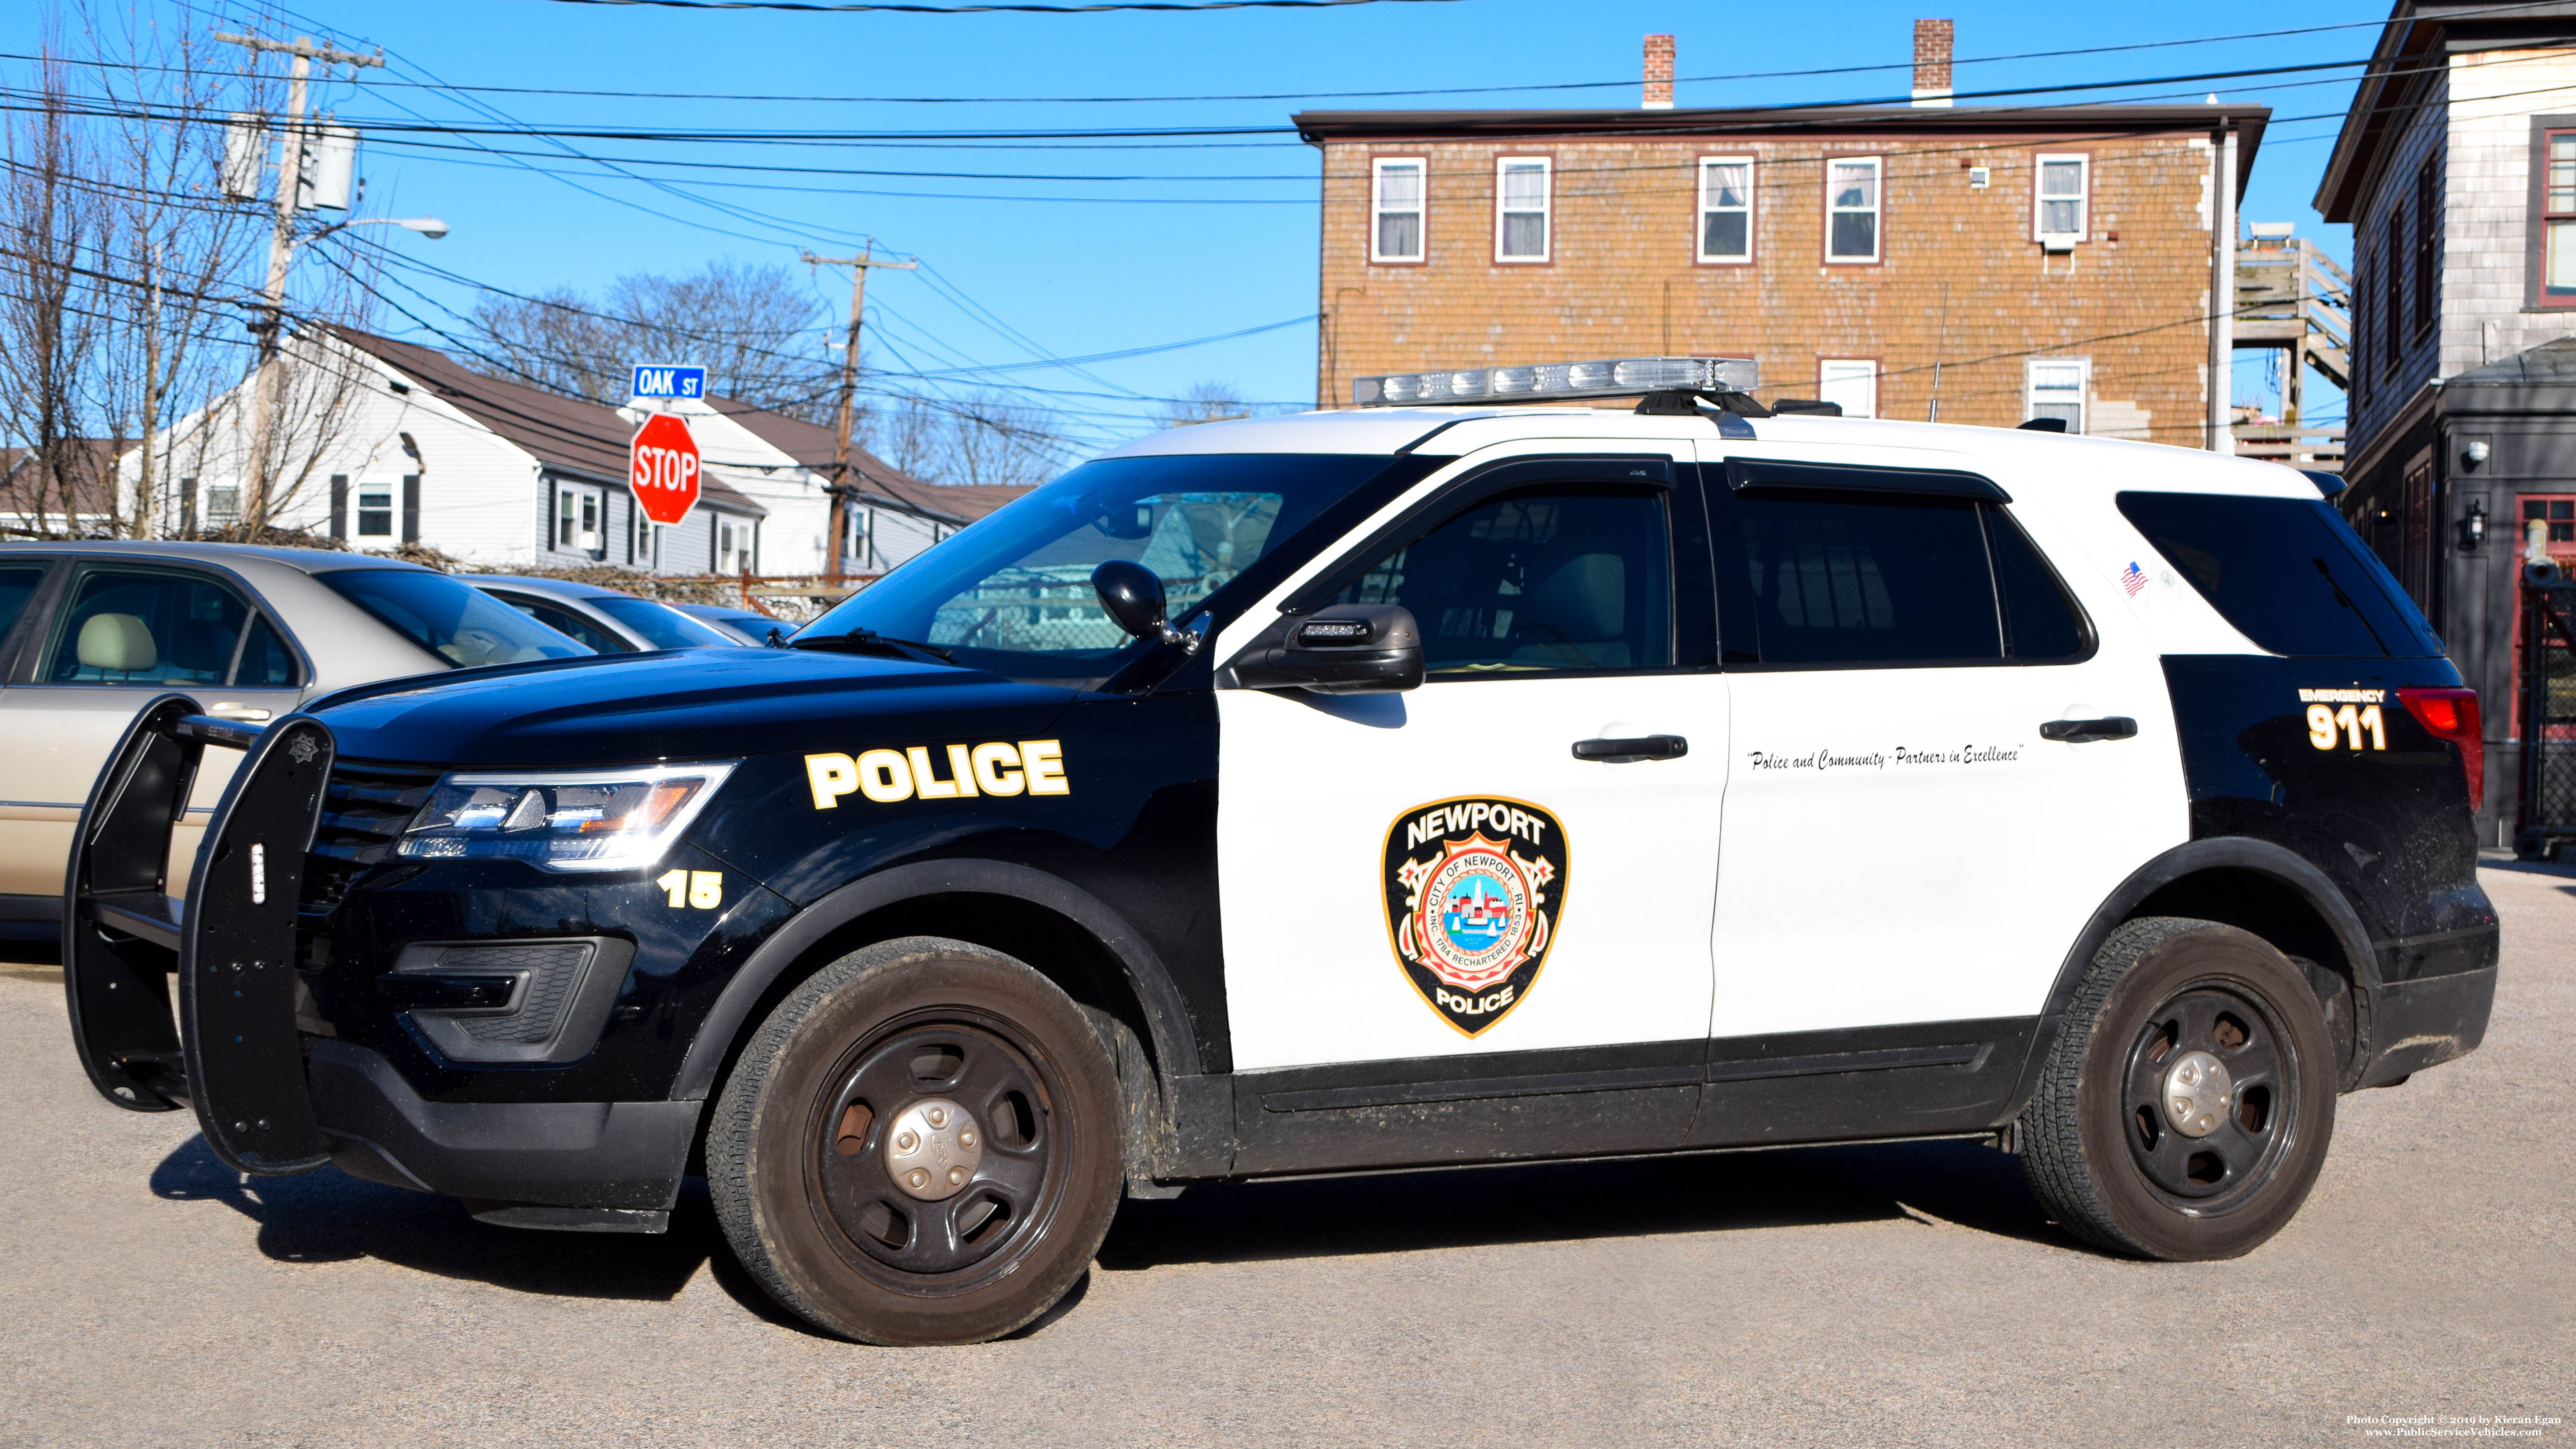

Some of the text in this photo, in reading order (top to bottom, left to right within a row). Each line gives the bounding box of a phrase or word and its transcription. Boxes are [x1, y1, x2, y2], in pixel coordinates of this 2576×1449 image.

[639, 369, 698, 396] OAK ST
[635, 444, 697, 492] STOP
[2298, 688, 2385, 702] EMERGENCY
[2307, 704, 2385, 750] 911
[804, 739, 1070, 810] POLICE
[1793, 752, 1814, 768] and
[1818, 749, 1885, 770] Community
[1896, 746, 1945, 765] Partners
[1949, 750, 1960, 762] in
[1407, 802, 1546, 850] NEWPORT
[656, 869, 722, 910] 15
[1429, 855, 1523, 906] CITY OF NEWPORT RI
[1436, 938, 1451, 956] 1784
[1452, 939, 1511, 967] RECHARTERED
[1510, 914, 1522, 936] 1853
[1436, 985, 1514, 1014] POLICE
